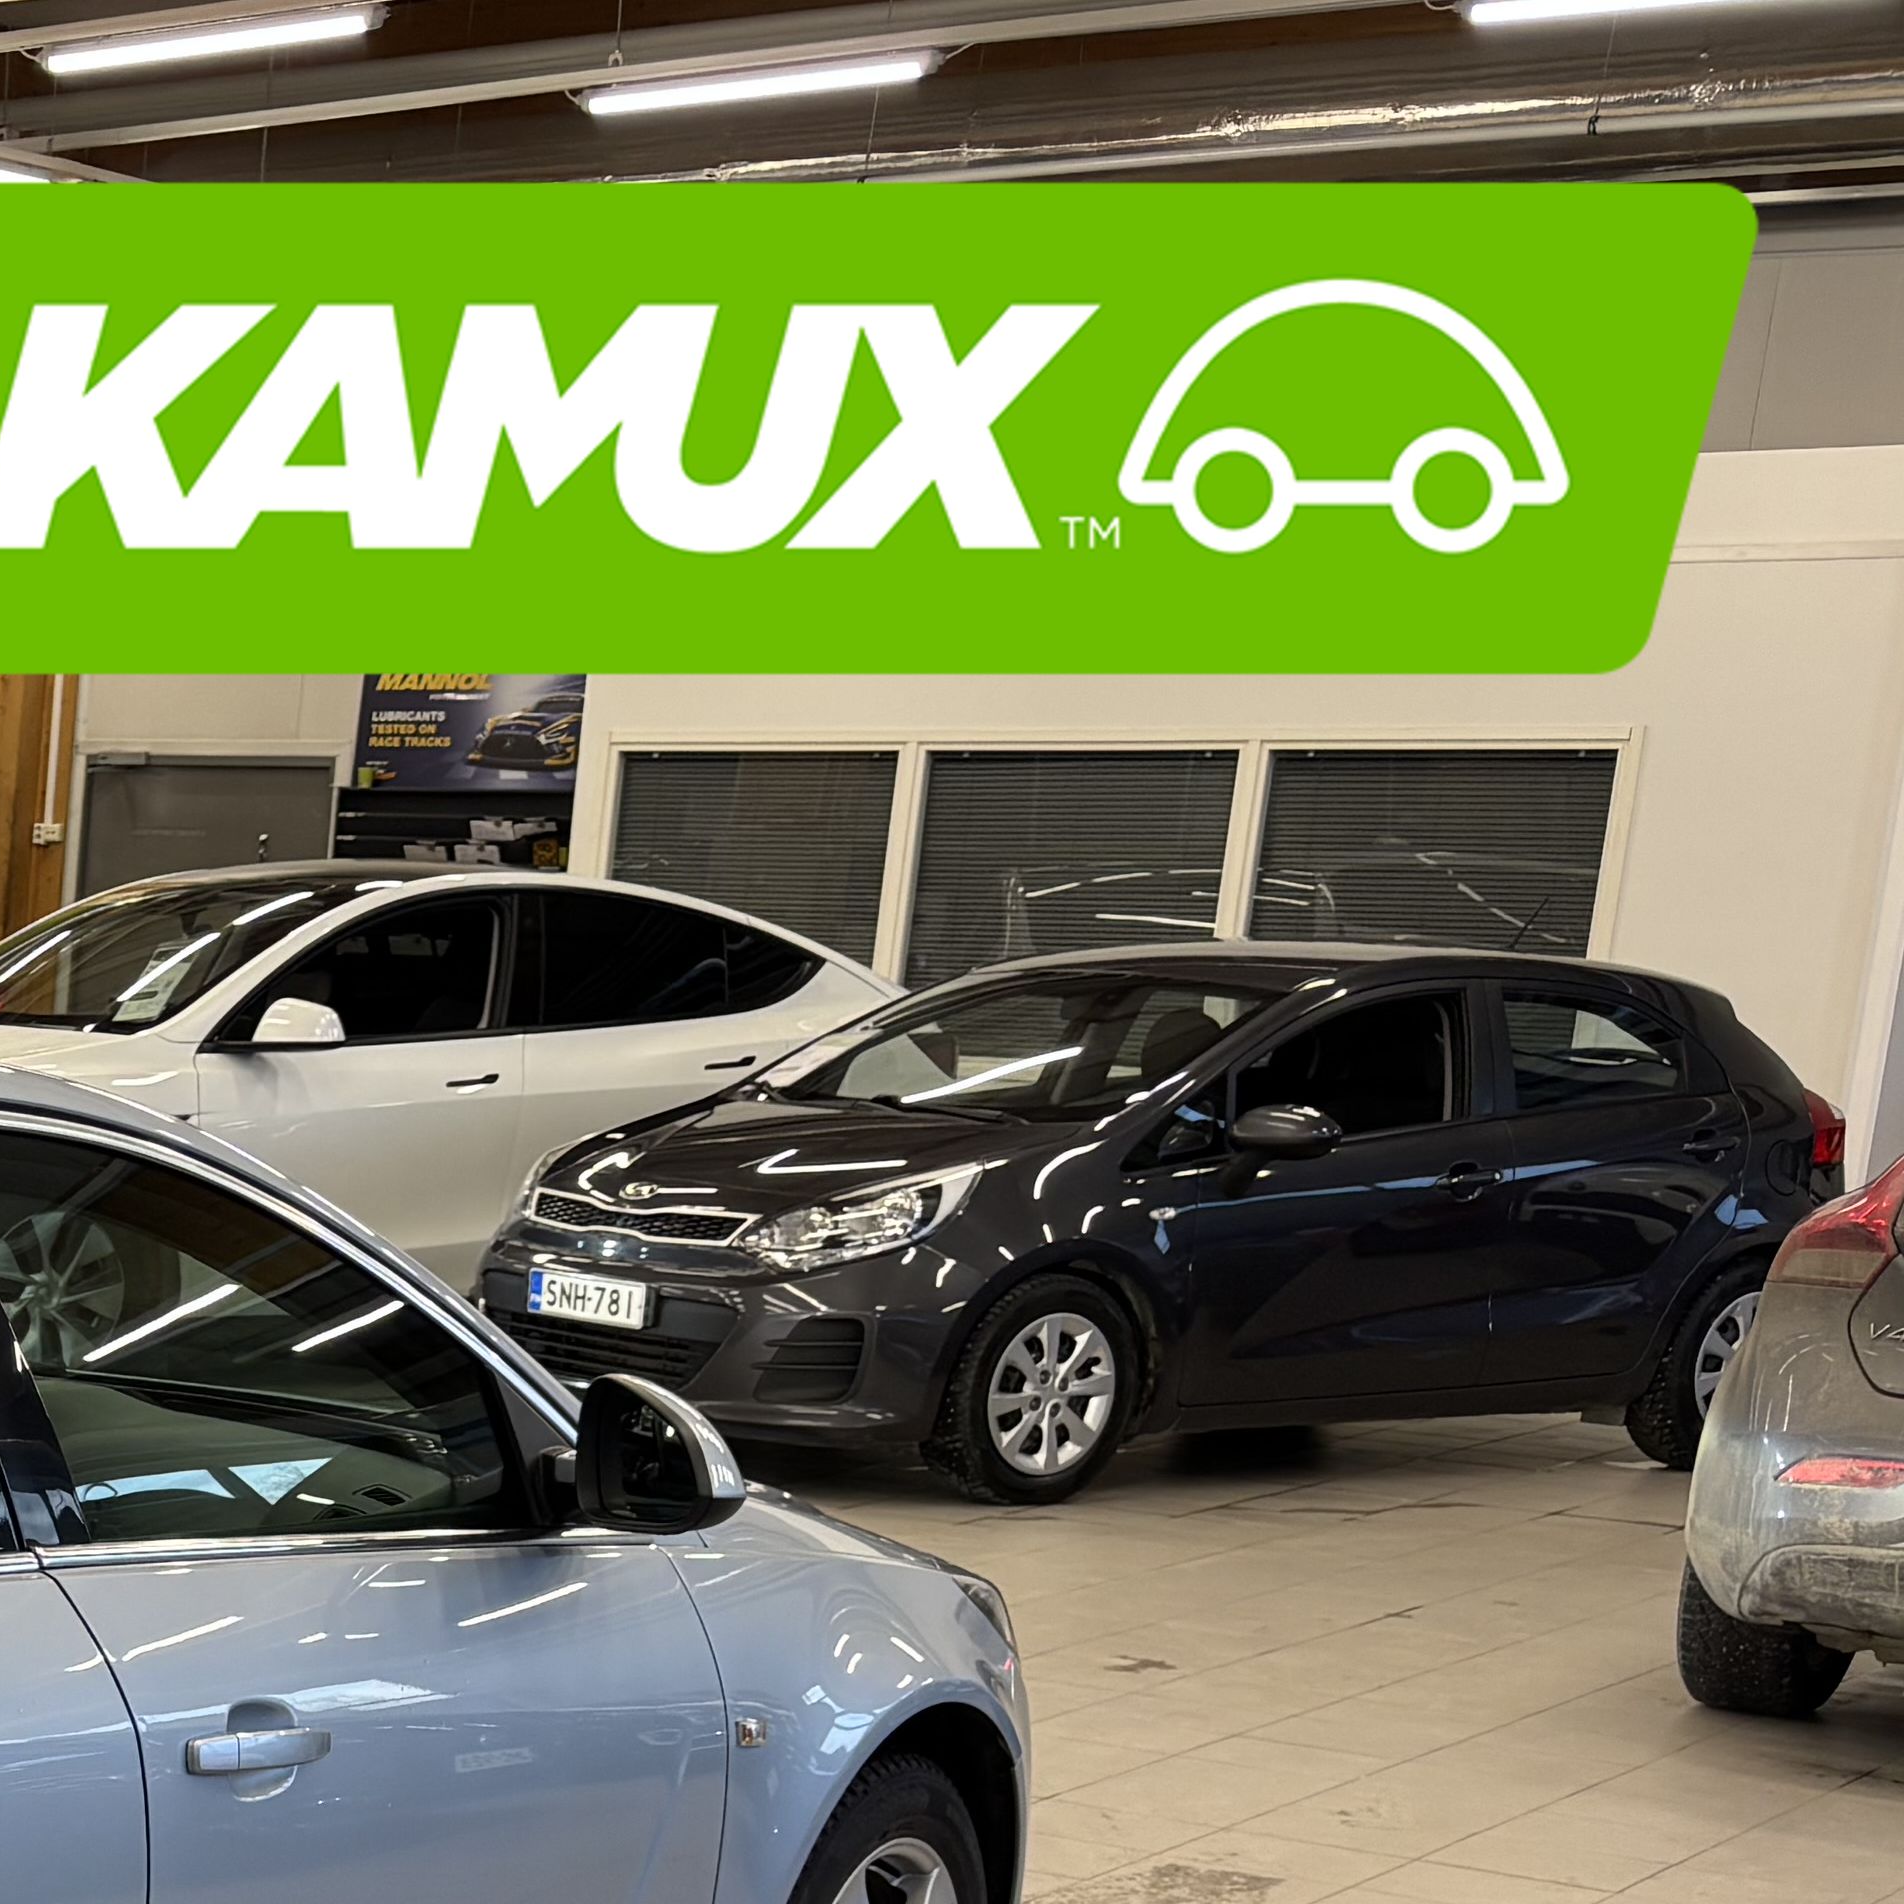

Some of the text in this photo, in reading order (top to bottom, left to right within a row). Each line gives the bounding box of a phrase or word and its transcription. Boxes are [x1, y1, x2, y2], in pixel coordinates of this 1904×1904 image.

[376, 673, 492, 691] MANNOL
[371, 711, 445, 722] LUBRICANTS
[371, 724, 436, 735] TESTED ON
[369, 737, 451, 747] RACE TRACKS
[546, 1279, 634, 1319] SNH-781
